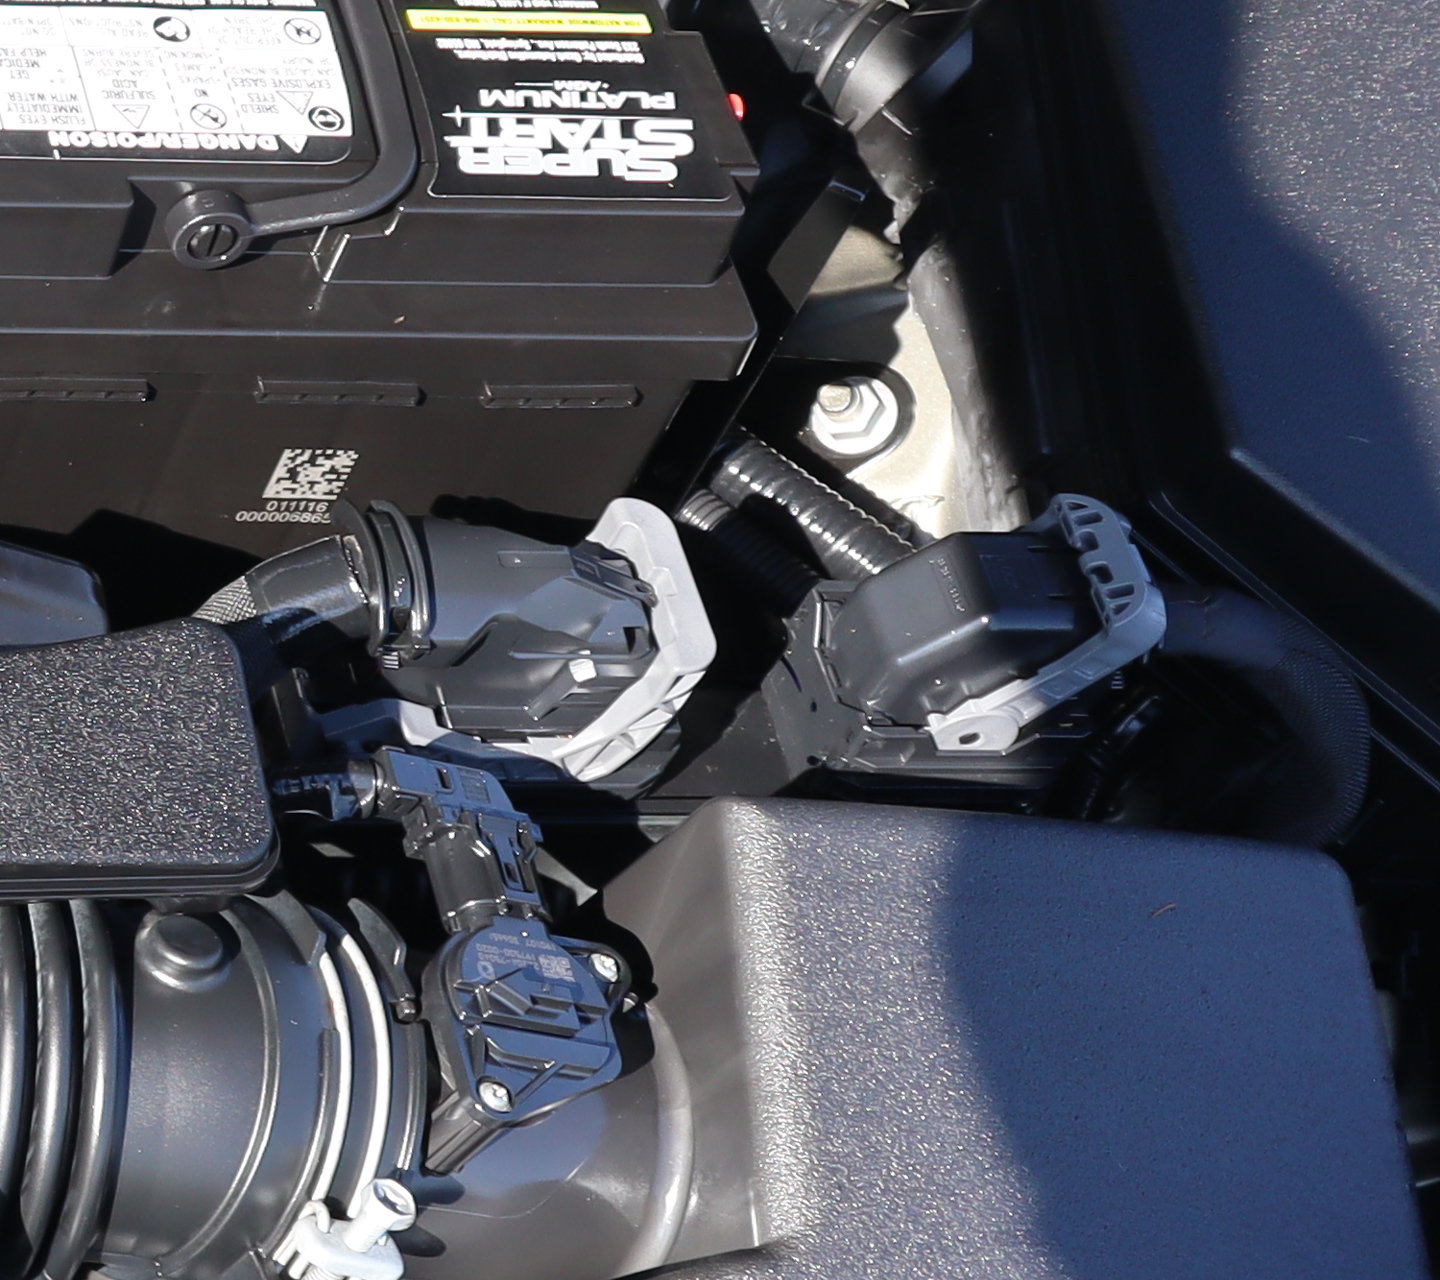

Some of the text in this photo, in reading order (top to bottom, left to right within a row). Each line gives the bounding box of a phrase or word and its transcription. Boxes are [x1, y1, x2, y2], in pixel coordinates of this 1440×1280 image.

[479, 88, 676, 111] PLATINUM
[47, 130, 280, 152] DANGER/POISON
[443, 118, 695, 158] START
[458, 146, 679, 183] SUPER
[266, 500, 329, 512] 011116
